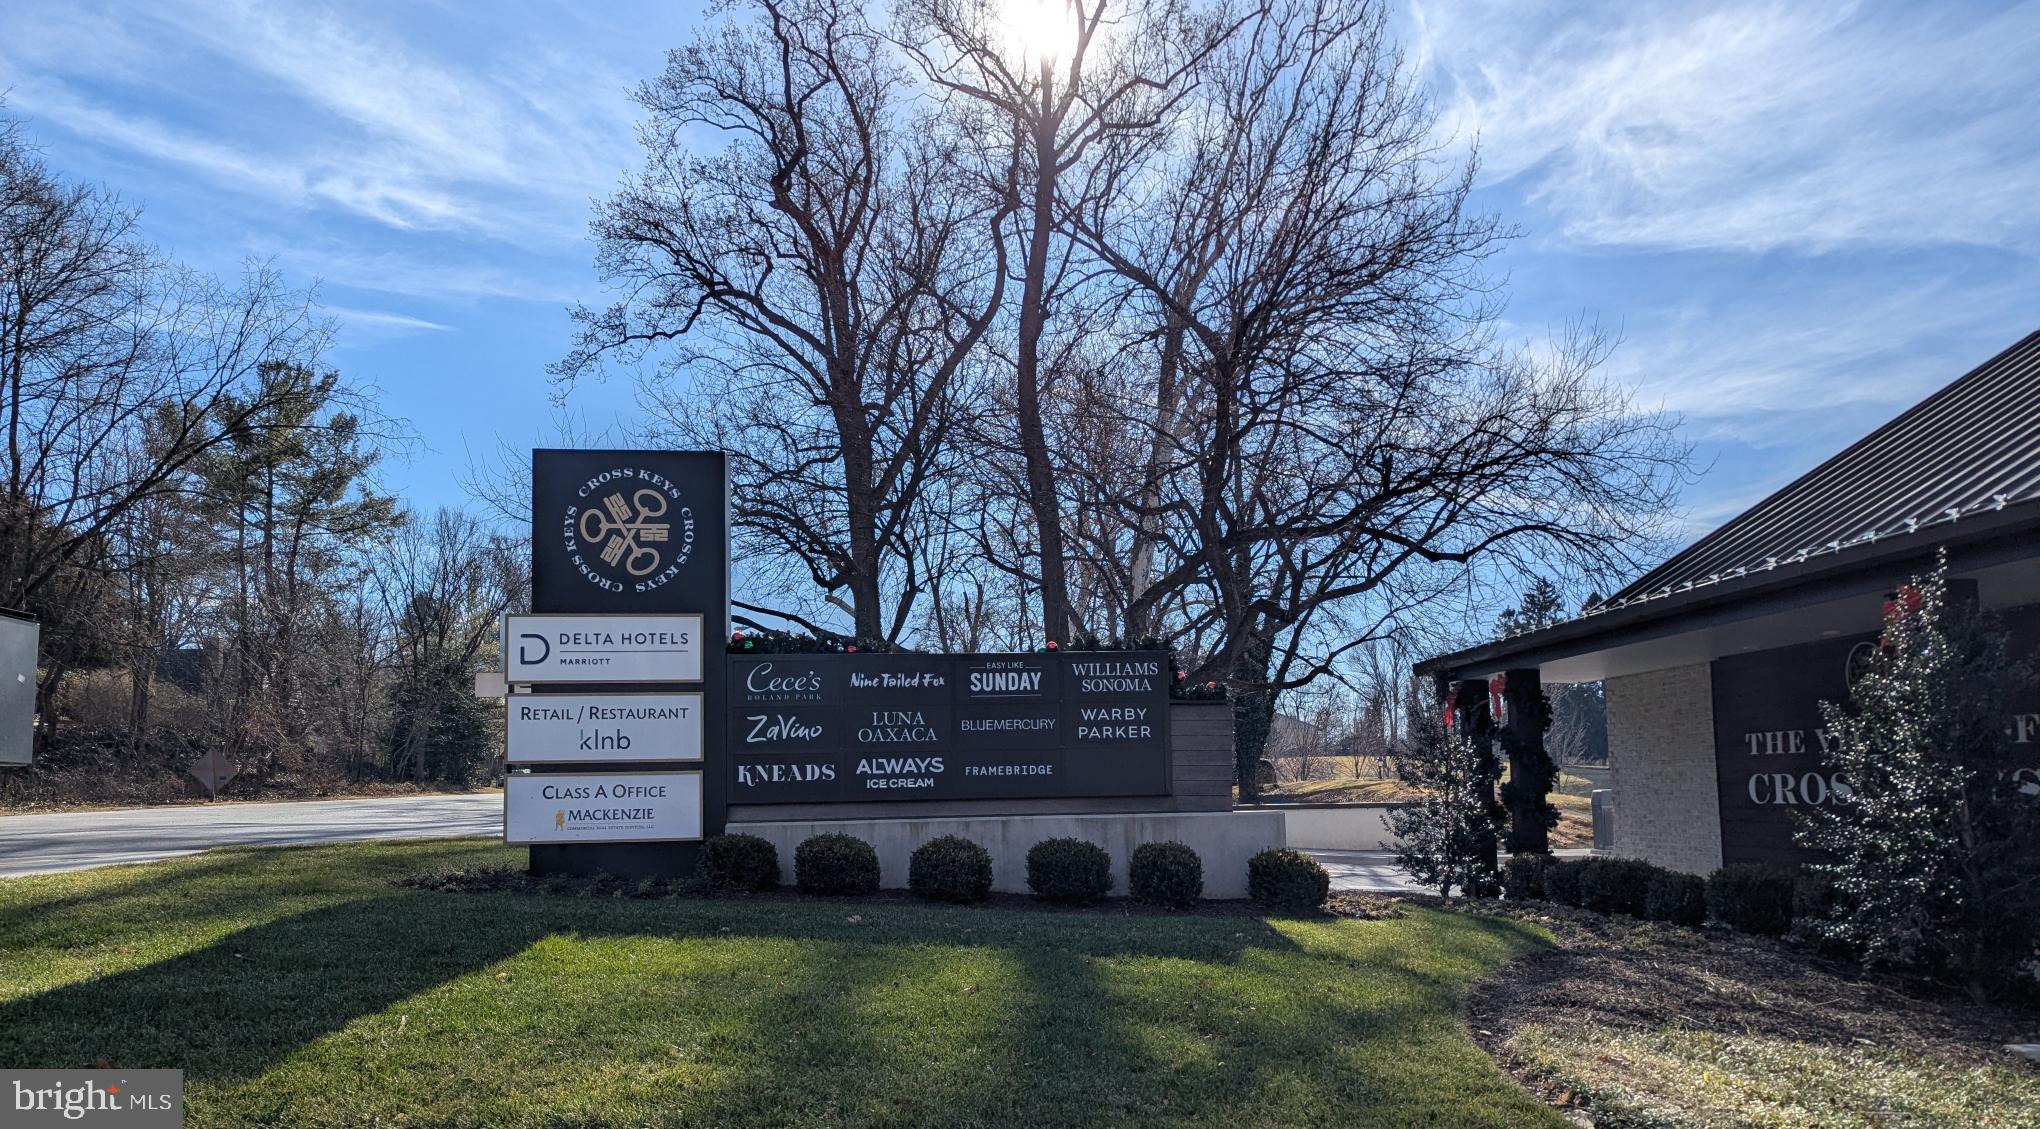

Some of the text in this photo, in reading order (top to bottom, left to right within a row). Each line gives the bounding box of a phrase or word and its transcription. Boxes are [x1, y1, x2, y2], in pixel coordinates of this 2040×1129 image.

[578, 468, 681, 499] CROSS KEYS
[564, 505, 623, 593] CROSS KEYS
[635, 507, 694, 593] CROSS KEYS
[559, 632, 689, 645] DELTA HOTELS
[986, 661, 1024, 669] EASY LIKE
[1072, 662, 1159, 677] WILLIAMS
[747, 662, 822, 693] Cece's
[850, 672, 945, 688] Nine Tailed Fox
[970, 671, 1042, 692] SUNDAY
[1081, 678, 1152, 693] SONOMA
[872, 711, 925, 726] LUNA
[1081, 708, 1147, 721] WARBY
[746, 714, 823, 743] ZaVino
[961, 718, 1056, 731] BLUEMERCURY
[1078, 725, 1152, 739] PARKER
[580, 729, 631, 751] klnb
[858, 727, 938, 743] OAXACA
[1745, 729, 1805, 755] THE
[855, 757, 945, 774] ALWAYS
[965, 765, 1053, 776] FRAMEBRIDGE
[737, 763, 836, 787] KNEADS
[866, 778, 934, 788] ICE CREAM
[542, 784, 667, 800] CLASS A OFFICE
[568, 808, 655, 821] MACKENZIE
